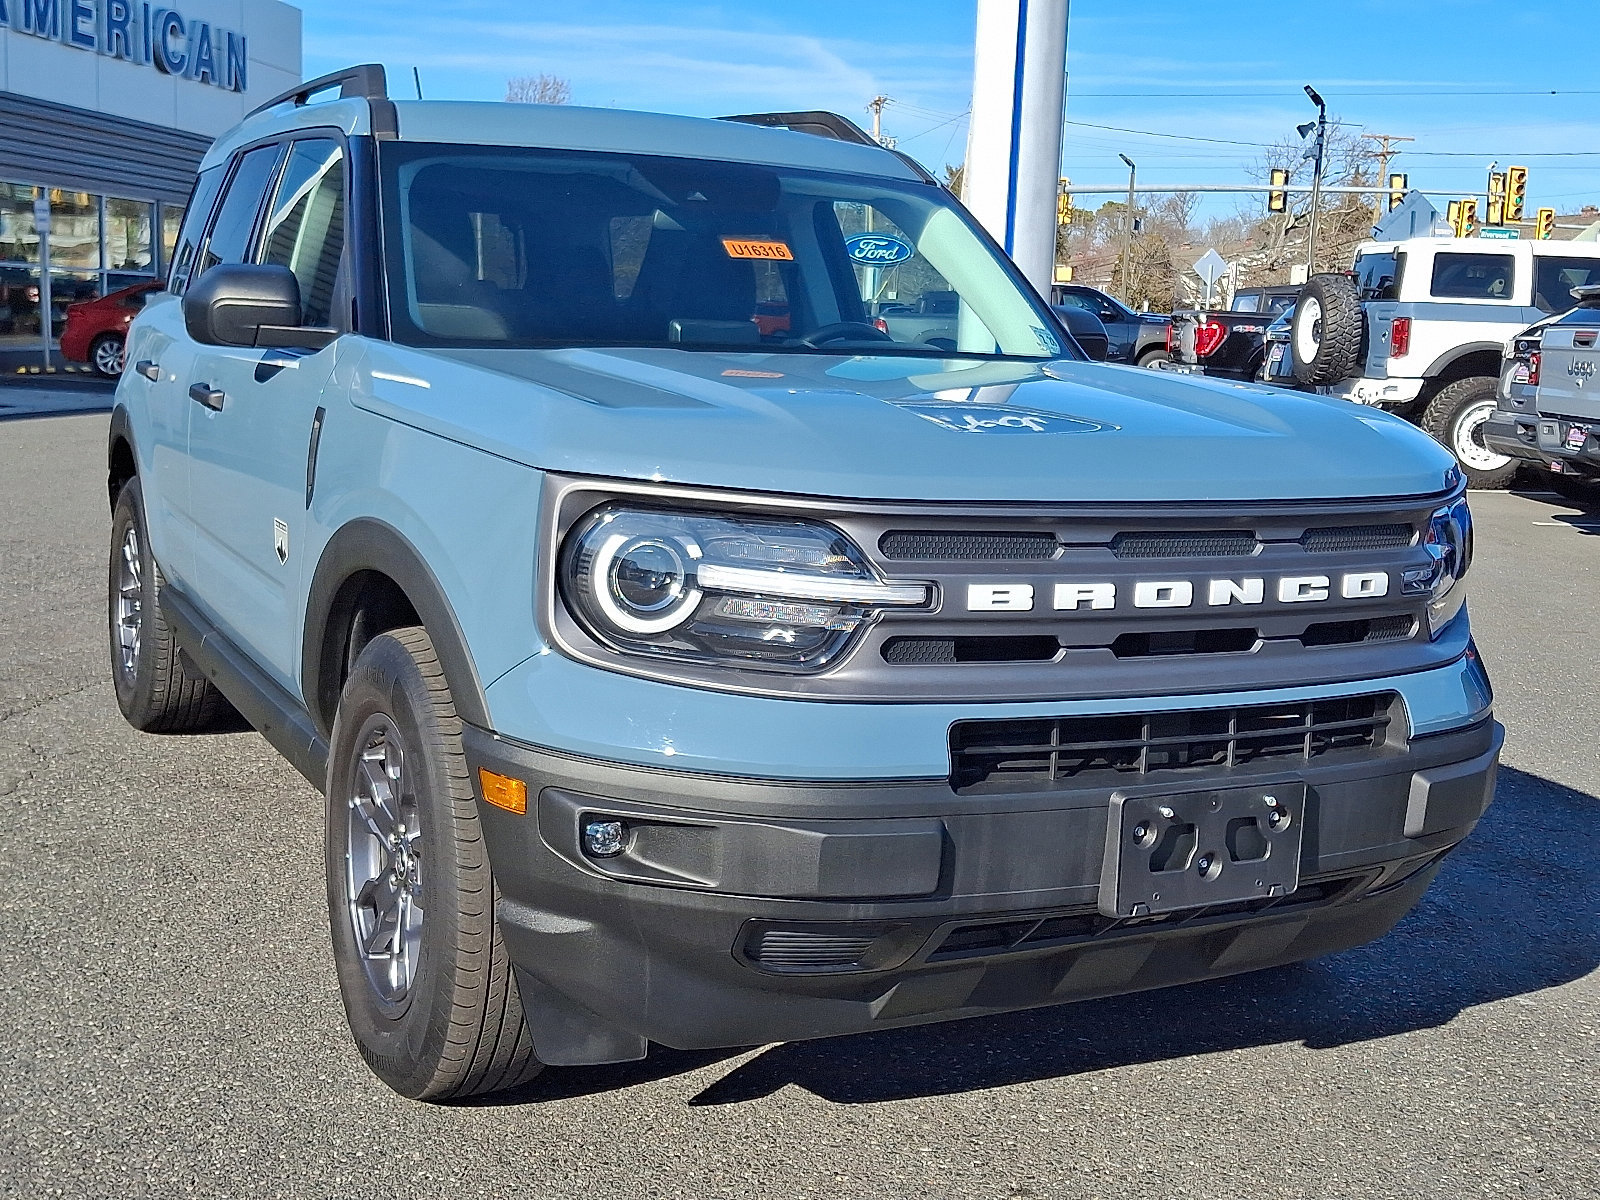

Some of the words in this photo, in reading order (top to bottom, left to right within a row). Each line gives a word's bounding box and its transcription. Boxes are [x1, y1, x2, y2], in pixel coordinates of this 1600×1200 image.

[0, 0, 249, 93] MERICAN
[732, 244, 787, 258] U16316
[855, 239, 899, 260] Ford
[1568, 355, 1595, 381] Jeep
[967, 571, 1389, 612] BRONCO
